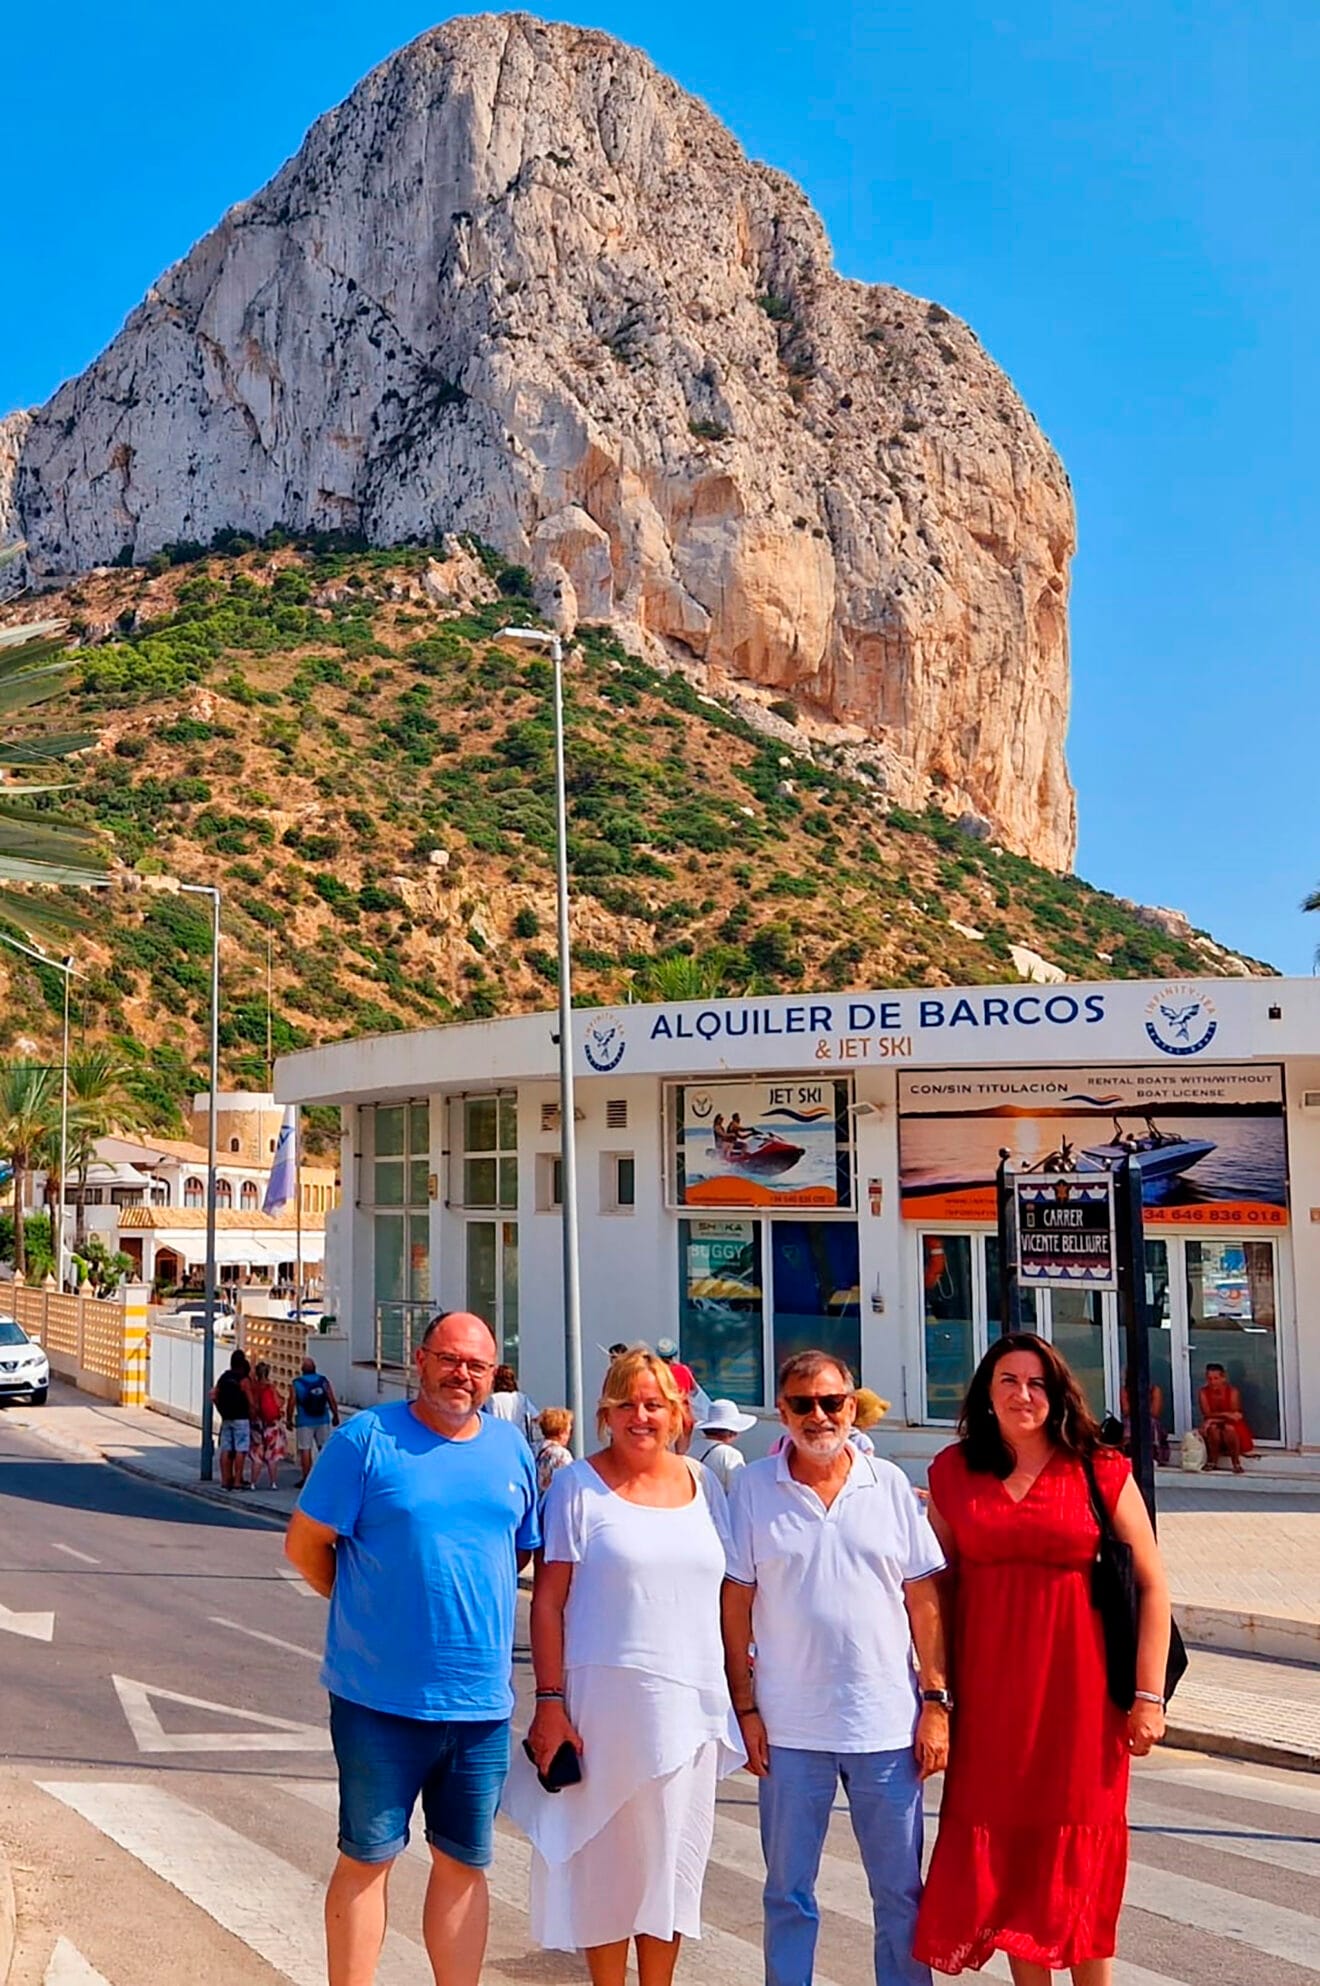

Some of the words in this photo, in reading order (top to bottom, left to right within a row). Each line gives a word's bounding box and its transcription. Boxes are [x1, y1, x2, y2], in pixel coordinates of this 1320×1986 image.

[650, 1006, 833, 1041] ALQUILER
[849, 1003, 901, 1030] DE
[919, 995, 1105, 1028] BARCOS
[815, 1039, 831, 1059] &
[839, 1038, 871, 1059] JET
[879, 1036, 912, 1057] SKI
[910, 1084, 972, 1094] CON/SIN
[977, 1082, 1068, 1094] TITULACIÓN
[1088, 1077, 1133, 1085] RENTAL
[1137, 1076, 1176, 1084] BOATS
[1180, 1075, 1273, 1084] WITH/WITHOUT
[769, 1088, 793, 1105] JET
[798, 1087, 822, 1103] SKI
[1137, 1089, 1168, 1098] BOAT
[1172, 1089, 1225, 1097] LICENSE
[1043, 1209, 1084, 1227] CARRER
[1171, 1209, 1204, 1220] 646
[1209, 1210, 1241, 1221] 836
[1247, 1211, 1281, 1221] 018
[1021, 1234, 1060, 1252] VICENTE
[1062, 1235, 1109, 1253] BELLIURE
